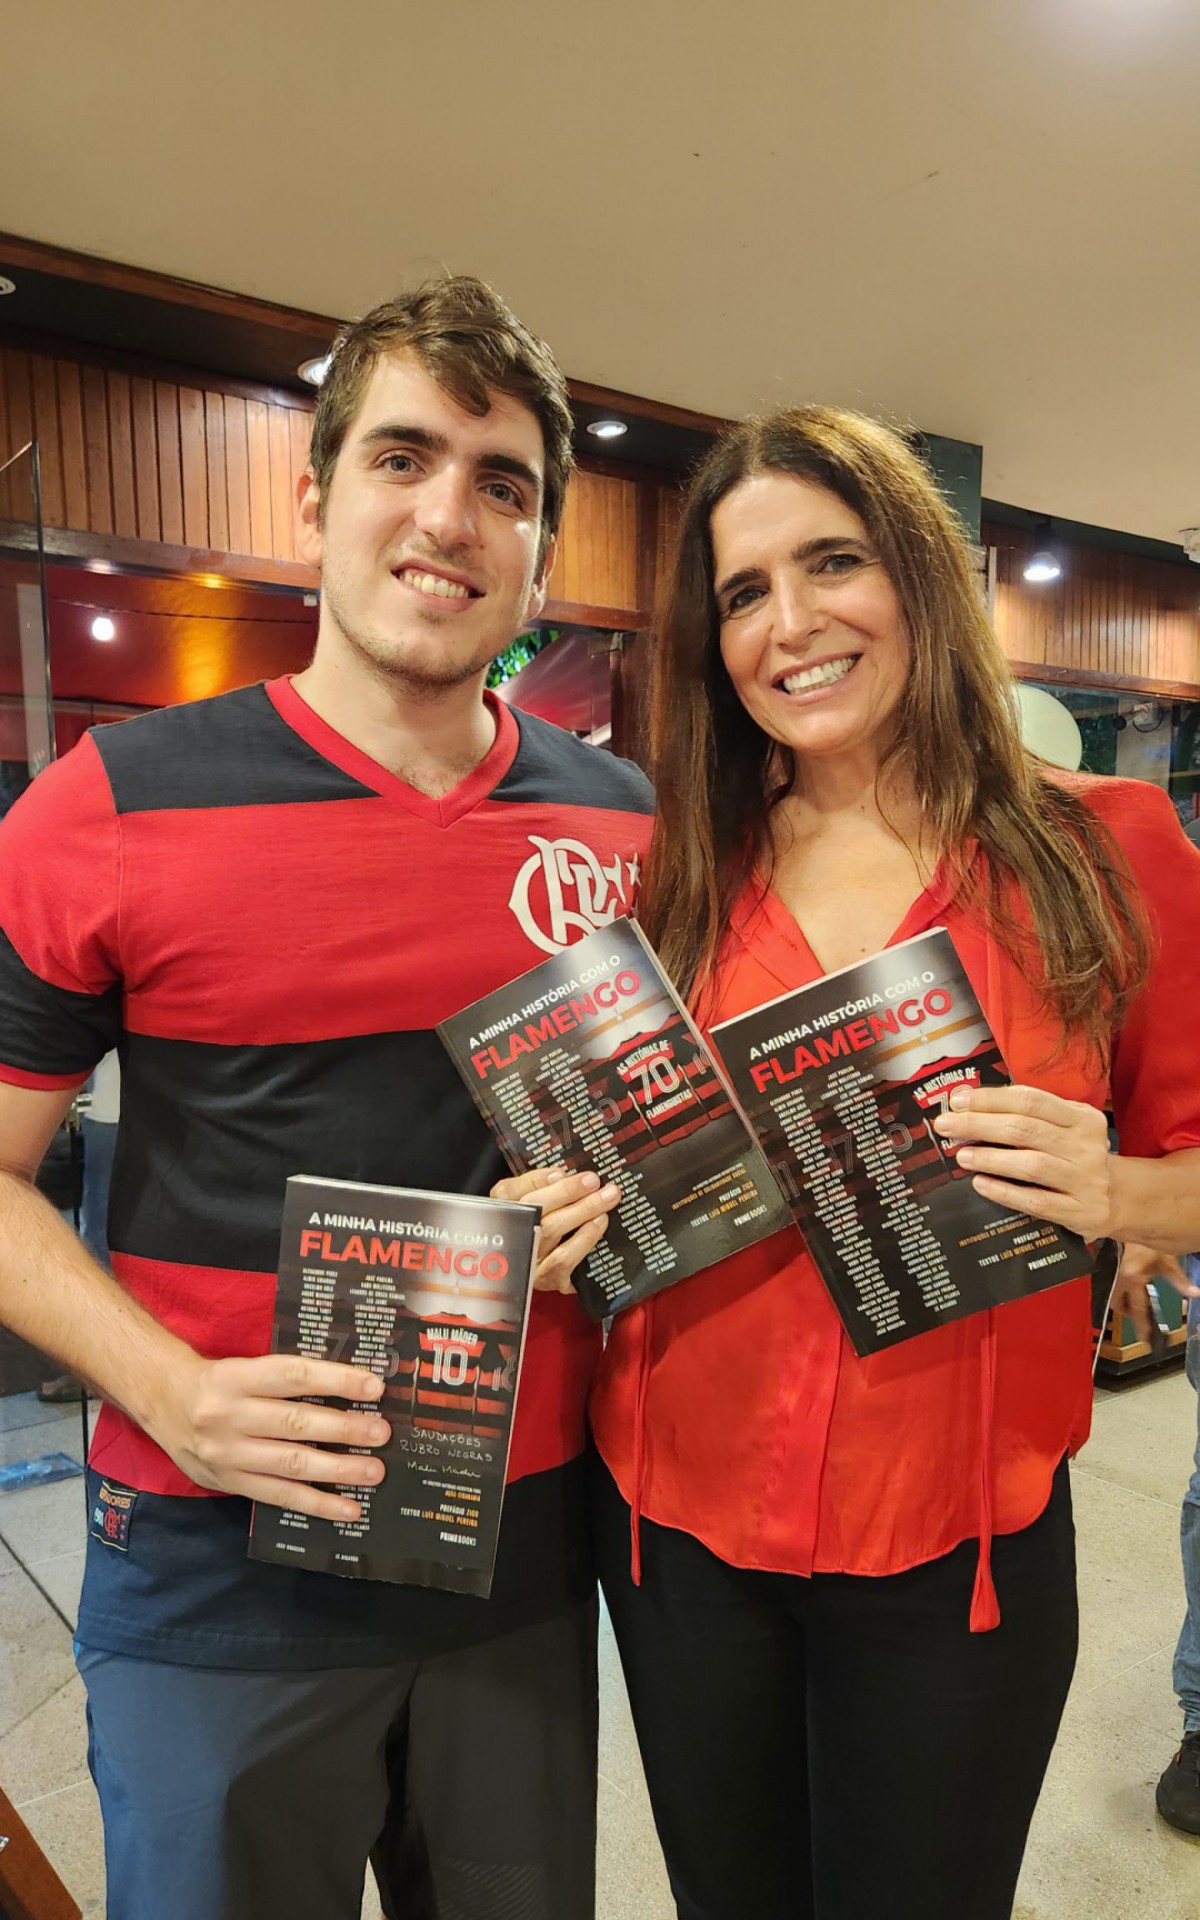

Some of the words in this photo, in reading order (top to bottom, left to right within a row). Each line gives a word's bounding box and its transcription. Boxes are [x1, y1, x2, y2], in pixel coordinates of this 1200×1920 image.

[468, 1036, 480, 1050] A
[478, 1012, 522, 1042] MINHA
[520, 975, 580, 1018] HISTÓRIA
[578, 960, 609, 984] COM
[608, 954, 621, 966] O
[471, 970, 640, 1077] FLAMENGO
[749, 1046, 762, 1060] A
[760, 1023, 813, 1053] MINHA
[812, 988, 883, 1030] HISTÓRIA
[883, 975, 920, 999] COM
[921, 970, 935, 983] O
[615, 1061, 629, 1076] AS
[623, 1042, 660, 1068] HISTÓRIAS
[657, 1038, 670, 1052] DE
[751, 989, 951, 1091] FLAMENGO
[629, 1055, 680, 1104] 70
[912, 1086, 927, 1101] AS
[922, 1068, 965, 1093] HISTÓRIAS
[964, 1066, 976, 1080] DE
[645, 1088, 692, 1119] FLAMENGUISTAS
[308, 1211, 321, 1225] A
[323, 1213, 376, 1231] MINHA
[378, 1219, 451, 1241] HISTÓRIA
[453, 1232, 488, 1245] COM
[491, 1234, 504, 1246] O
[300, 1230, 507, 1279] FLAMENGO
[425, 1327, 449, 1342] MALU
[431, 1342, 468, 1386] 10
[447, 1447, 492, 1462] NEGRAS
